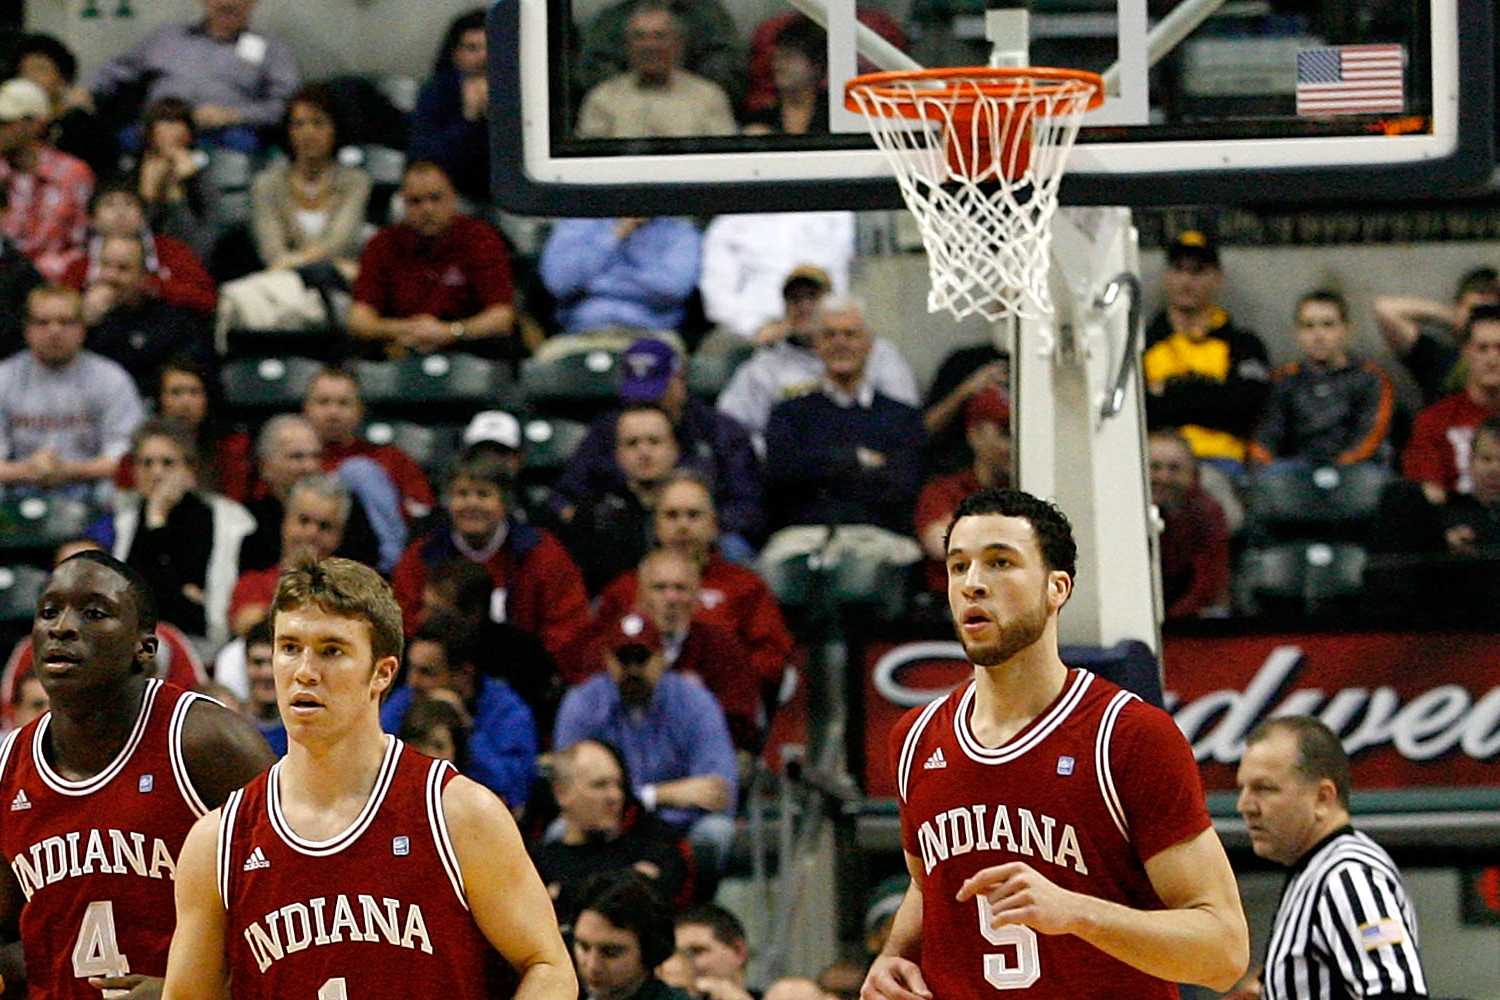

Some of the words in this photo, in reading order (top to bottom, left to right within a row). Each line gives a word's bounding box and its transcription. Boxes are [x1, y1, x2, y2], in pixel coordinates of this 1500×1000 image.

[11, 828, 178, 903] INDIANA
[917, 804, 1089, 876] INDIANA
[71, 900, 131, 1000] 4
[243, 894, 434, 974] INDIANA
[976, 893, 1042, 991] 5
